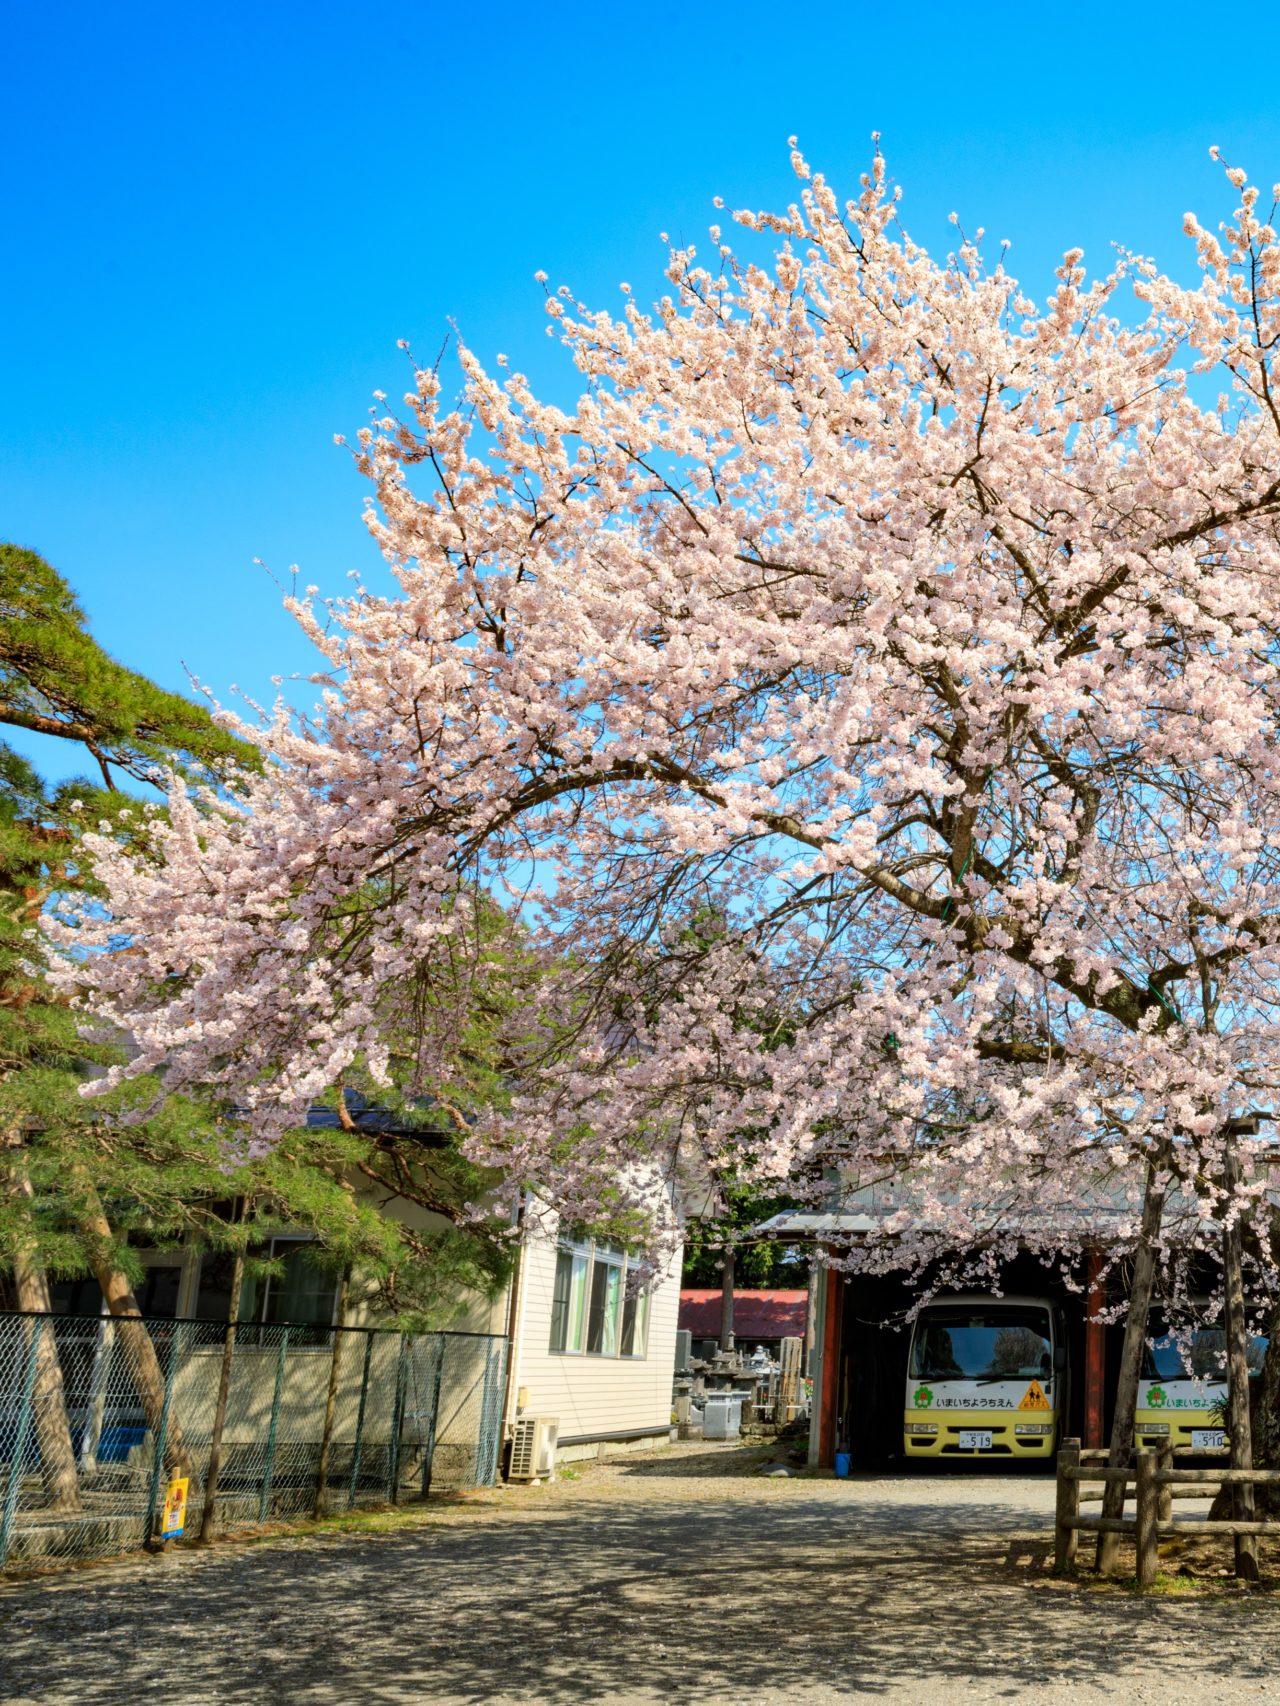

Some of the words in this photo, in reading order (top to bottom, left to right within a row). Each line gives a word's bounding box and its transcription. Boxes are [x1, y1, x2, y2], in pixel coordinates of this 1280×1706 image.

[936, 1398, 1014, 1408] いまいちようちえん
